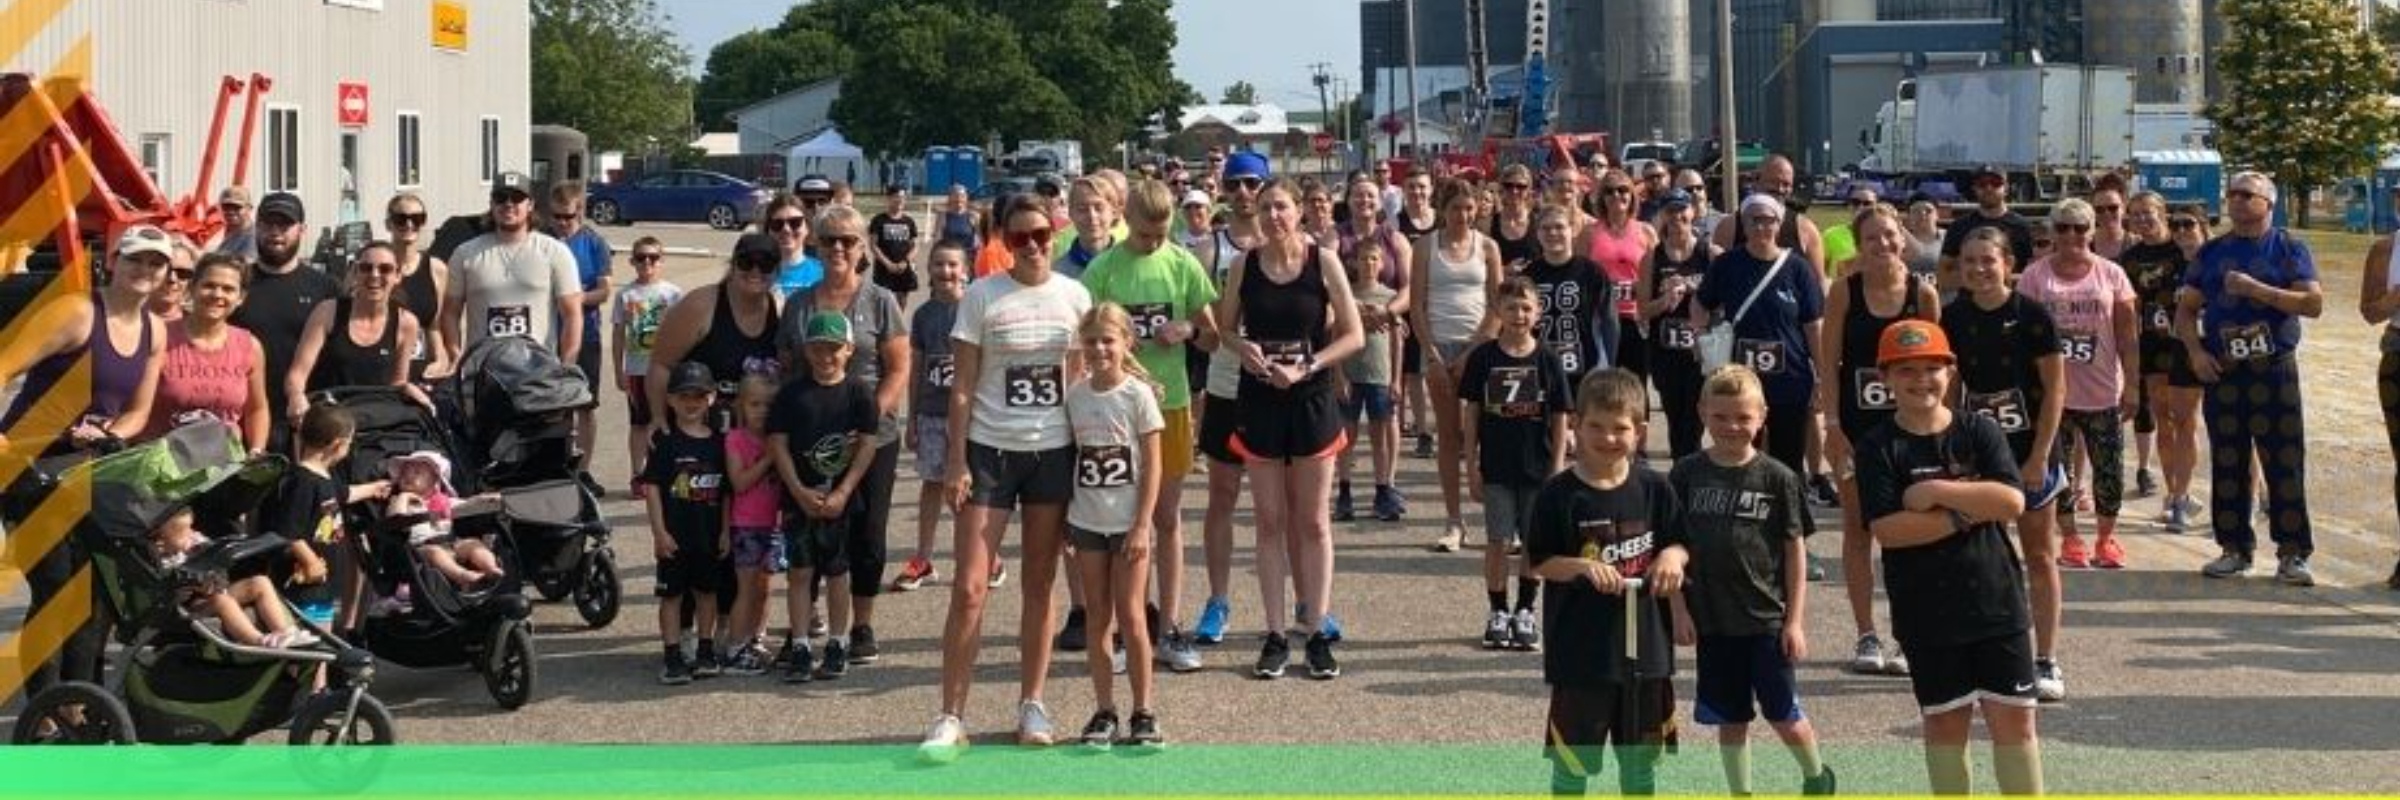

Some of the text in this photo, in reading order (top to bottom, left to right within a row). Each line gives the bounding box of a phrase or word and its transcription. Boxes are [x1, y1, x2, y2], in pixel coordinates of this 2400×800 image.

[489, 315, 527, 337] 68
[1668, 327, 1695, 348] 13
[2230, 334, 2269, 358] 84
[1745, 350, 1776, 372] 19
[929, 366, 955, 386] 42
[1010, 379, 1058, 405] 33
[1502, 380, 1520, 403] 7
[1863, 382, 1896, 405] 6
[1081, 458, 1128, 486] 32
[1602, 530, 1655, 564] CHEESE
